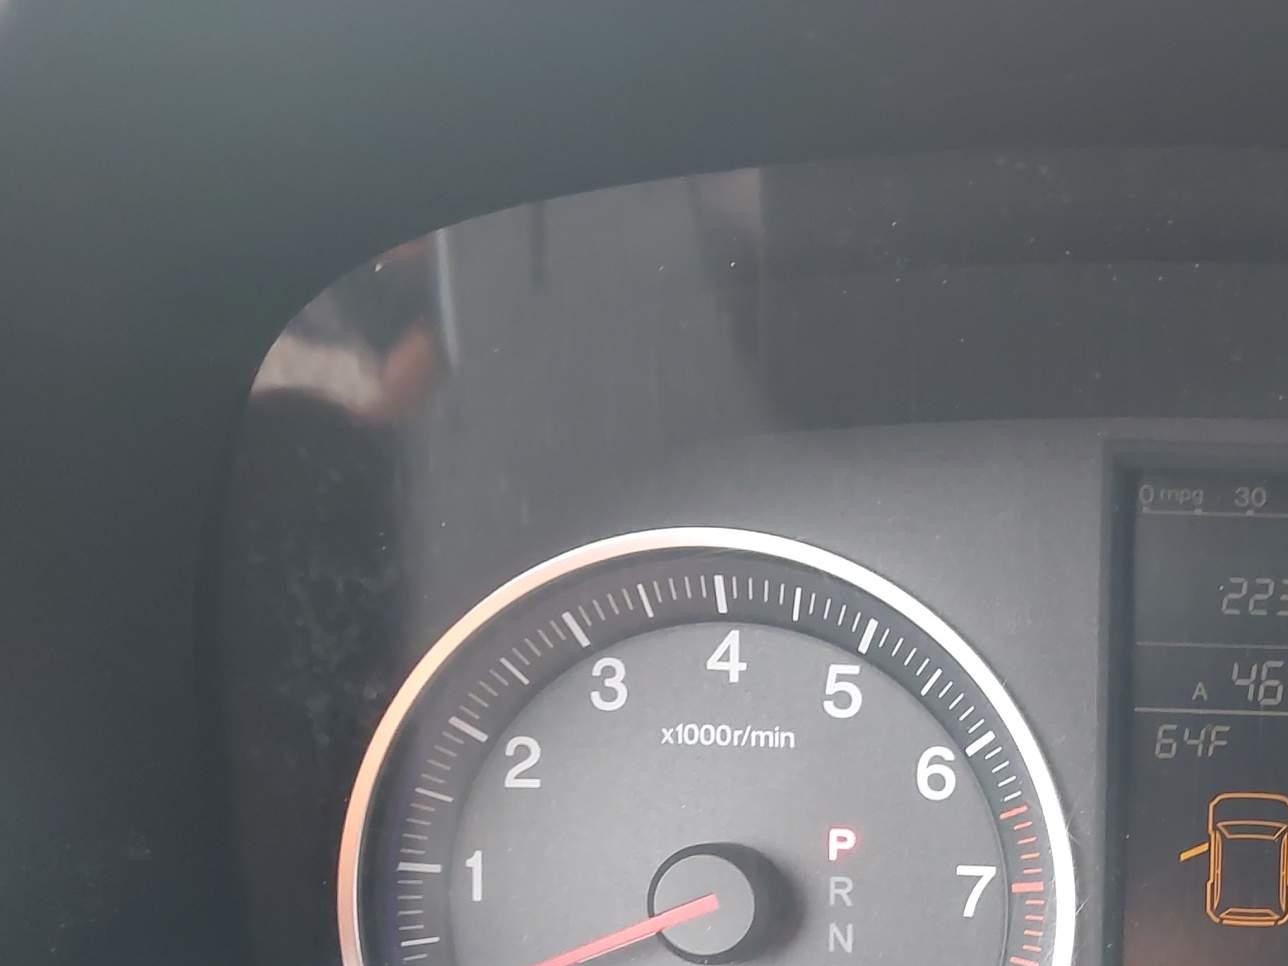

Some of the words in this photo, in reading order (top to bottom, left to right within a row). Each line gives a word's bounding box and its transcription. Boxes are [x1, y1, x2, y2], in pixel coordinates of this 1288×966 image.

[1138, 484, 1154, 504] 0
[1159, 486, 1204, 505] mpg
[1234, 486, 1267, 508] 30
[707, 630, 747, 683] 4
[590, 657, 628, 711] 3
[823, 664, 863, 718] 5
[1191, 681, 1209, 701] A
[660, 723, 796, 750] x1000r/min
[1154, 724, 1231, 759] 64F
[505, 736, 542, 788] 2
[916, 746, 956, 801] 6
[828, 829, 858, 861] P
[465, 850, 484, 902] 1
[829, 876, 854, 908] R
[956, 864, 997, 917] 7
[829, 922, 853, 953] N
